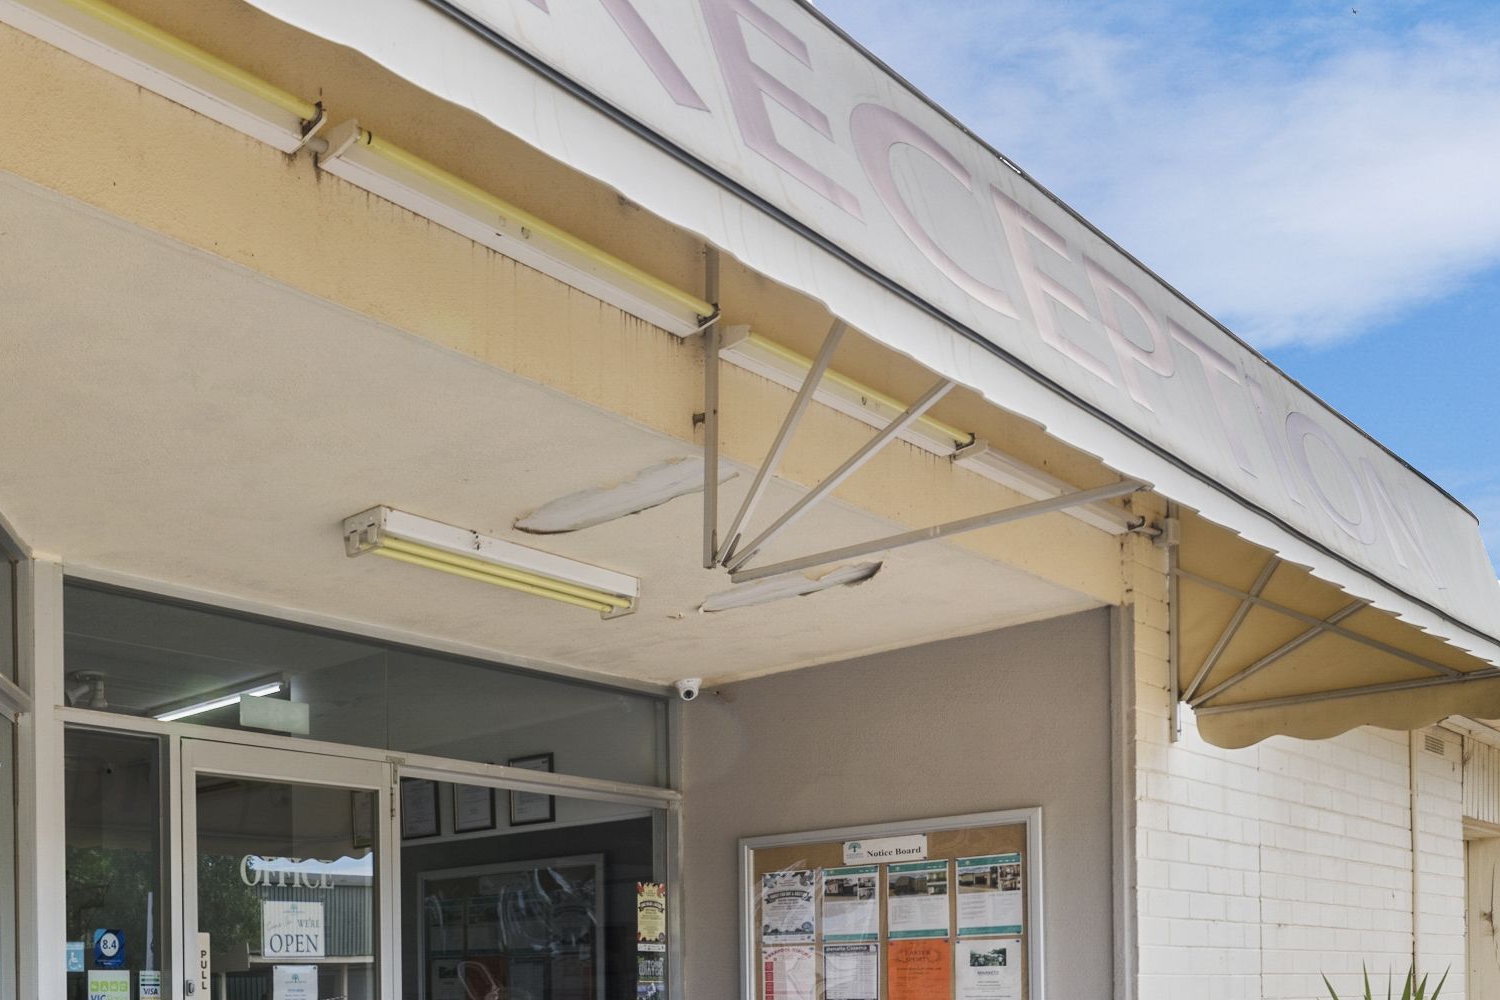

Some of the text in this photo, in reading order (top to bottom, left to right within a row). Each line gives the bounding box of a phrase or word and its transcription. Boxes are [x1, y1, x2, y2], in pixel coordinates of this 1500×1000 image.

[866, 850, 893, 858] Notice
[895, 846, 922, 855] Board
[239, 854, 335, 889] OFFICE
[102, 939, 117, 950] 8.4
[269, 933, 319, 954] OPEN
[200, 950, 208, 991] PULL
[143, 987, 159, 996] VISA
